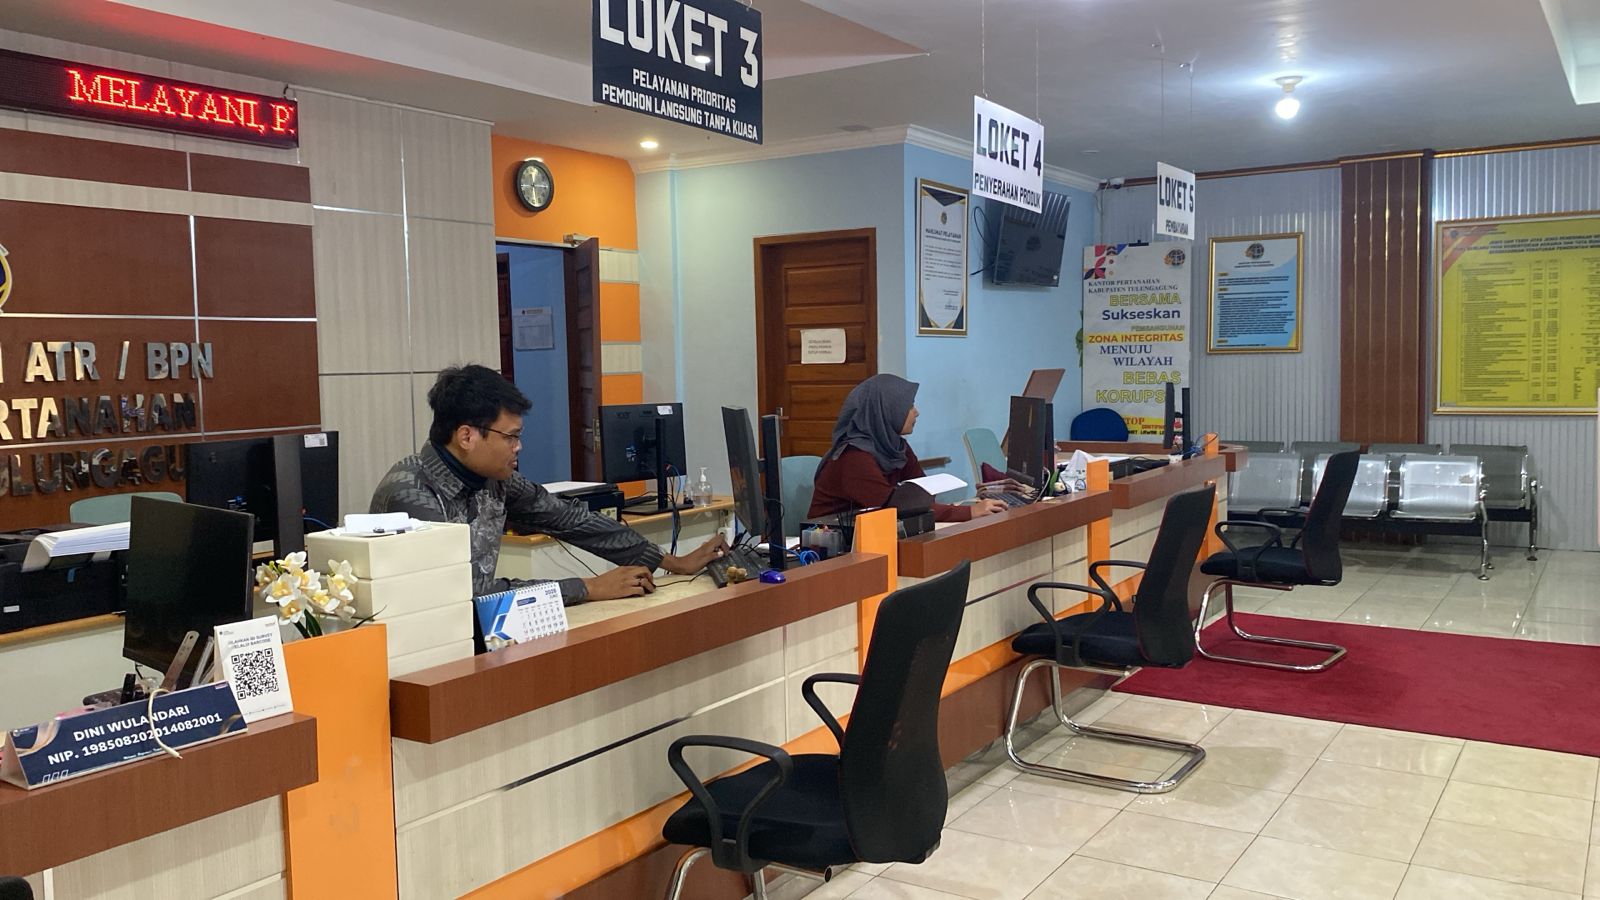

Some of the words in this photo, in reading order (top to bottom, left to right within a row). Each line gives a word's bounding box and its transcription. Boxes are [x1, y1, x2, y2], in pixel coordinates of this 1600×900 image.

[600, 0, 728, 77] LOKET
[739, 27, 759, 89] 3
[68, 70, 265, 135] MELAYANI,
[271, 103, 295, 134] P
[633, 68, 689, 100] PELAYANAN
[691, 85, 736, 114] PRIORITAS
[602, 83, 652, 112] PEMOHON
[654, 97, 702, 125] LANGSUNG
[704, 111, 730, 133] TANPA
[732, 119, 758, 140] KUASA
[976, 113, 1029, 171] LOKET
[1033, 140, 1042, 176] 4
[974, 173, 1019, 200] PENYERAHAN
[1019, 185, 1042, 209] PRODUK
[1159, 175, 1187, 211] LOKET
[1189, 184, 1194, 213] 5
[1088, 286, 1126, 294] KABUPATEN
[1109, 293, 1182, 307] BERSAMA
[1102, 308, 1181, 320] Sukseskan
[1088, 335, 1118, 343] ZONA
[1121, 333, 1184, 343] INTEGRITAS
[1100, 345, 1152, 354] MENUJU
[25, 341, 99, 383] ATR
[118, 341, 130, 380] /
[147, 342, 214, 380] BPN
[1113, 356, 1173, 366] WILAYAH
[1122, 371, 1182, 385] BEBAS
[1096, 389, 1166, 404] KORUPS
[1124, 416, 1145, 425] TOP
[48, 750, 79, 765] NIP.
[82, 712, 222, 756] 198508202014082001
[73, 724, 104, 743] DINI
[109, 704, 190, 733] WULANDARI
